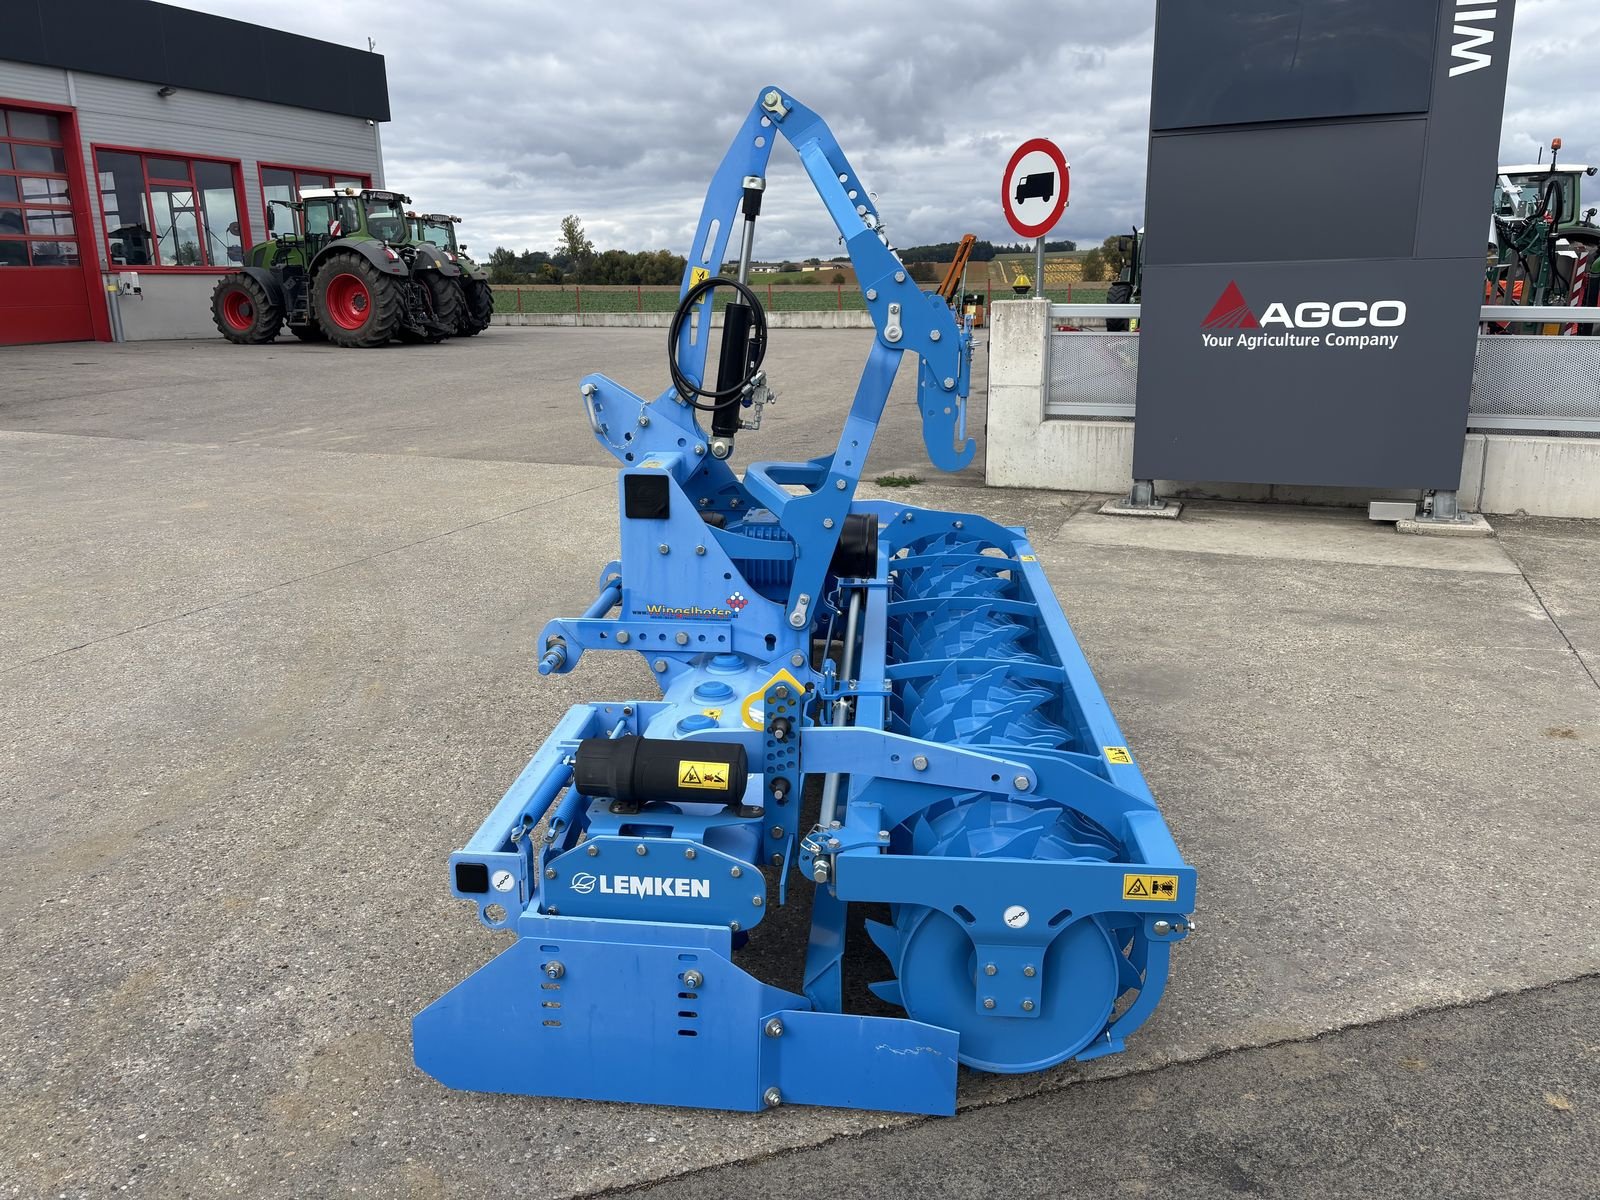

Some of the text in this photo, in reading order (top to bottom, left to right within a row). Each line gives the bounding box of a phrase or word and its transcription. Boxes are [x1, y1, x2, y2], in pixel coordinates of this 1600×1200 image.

[1448, 0, 1498, 78] WI
[1259, 300, 1407, 329] AGCO
[1201, 332, 1399, 351] Your Agriculture Company
[599, 874, 710, 900] LEMKEN
